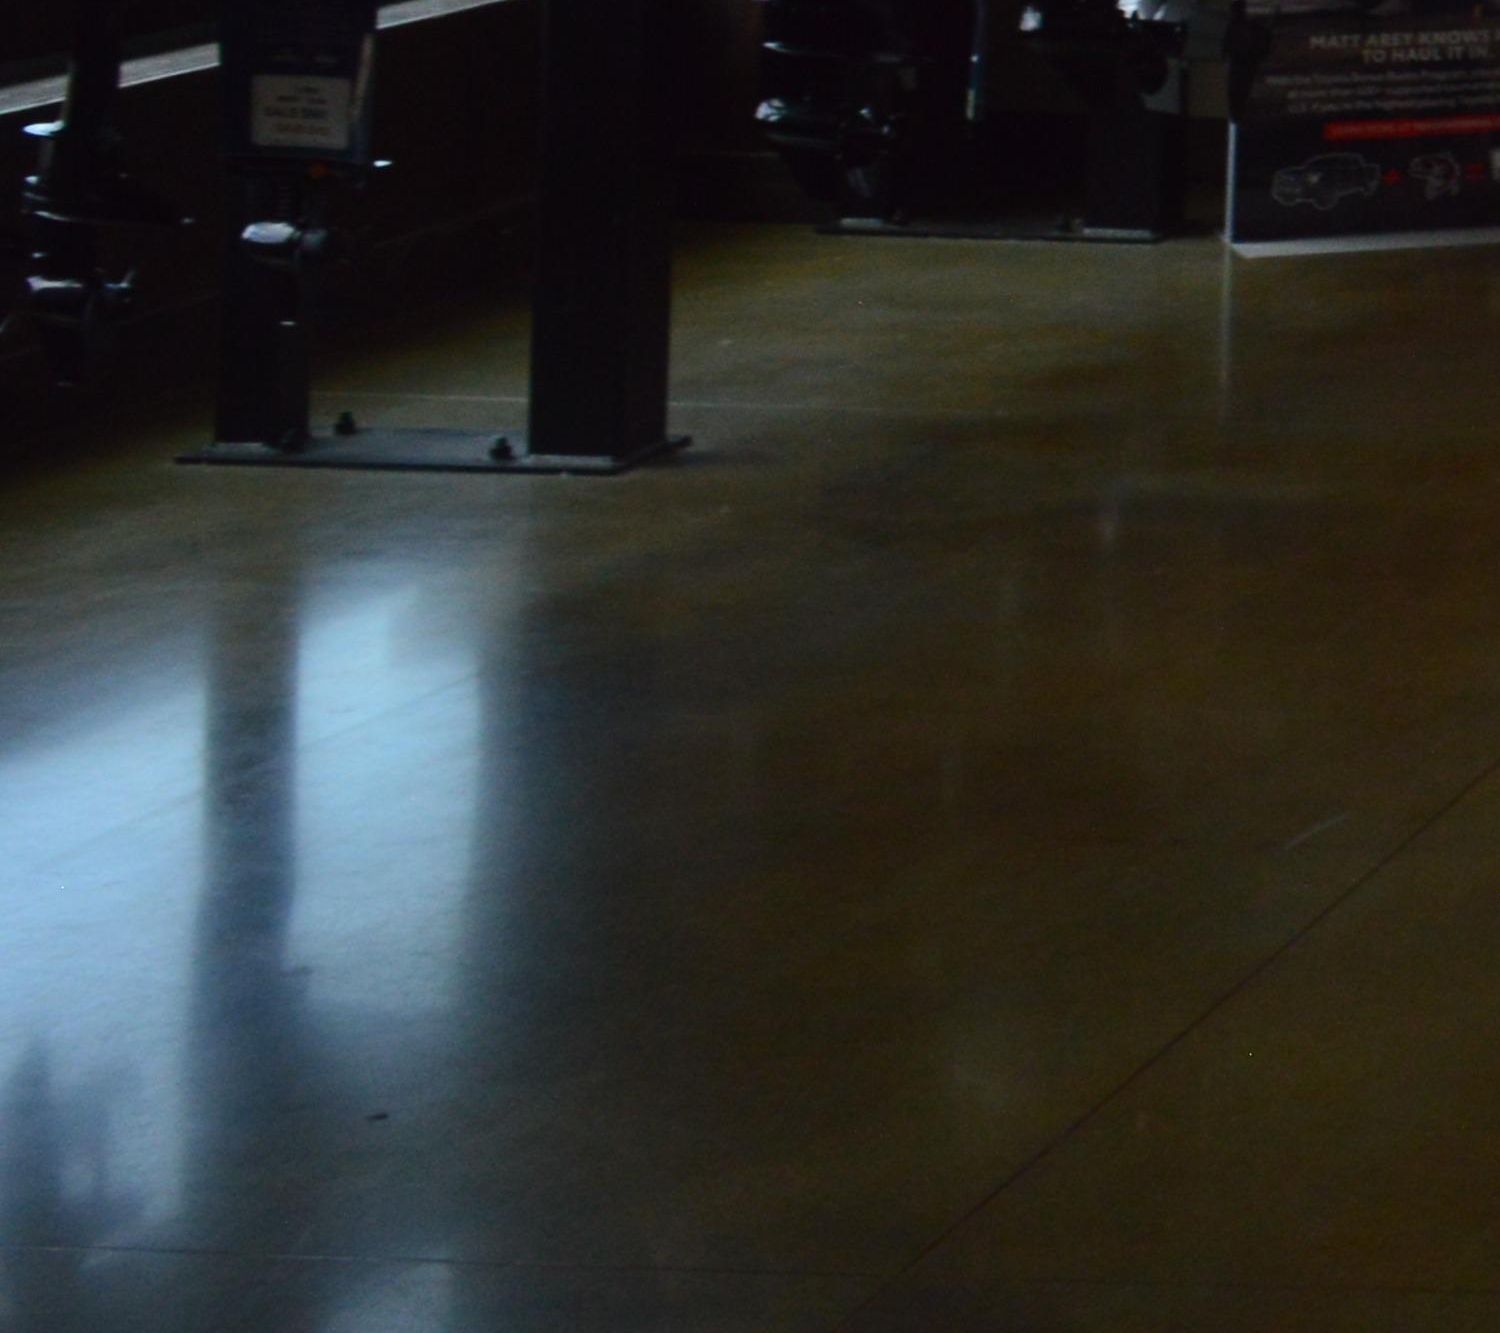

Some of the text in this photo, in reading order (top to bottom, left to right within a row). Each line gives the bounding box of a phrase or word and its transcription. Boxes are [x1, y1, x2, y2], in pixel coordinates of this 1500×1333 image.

[1309, 33, 1362, 50] MATT
[1362, 49, 1388, 64] TO
[1391, 47, 1442, 62] HAUL
